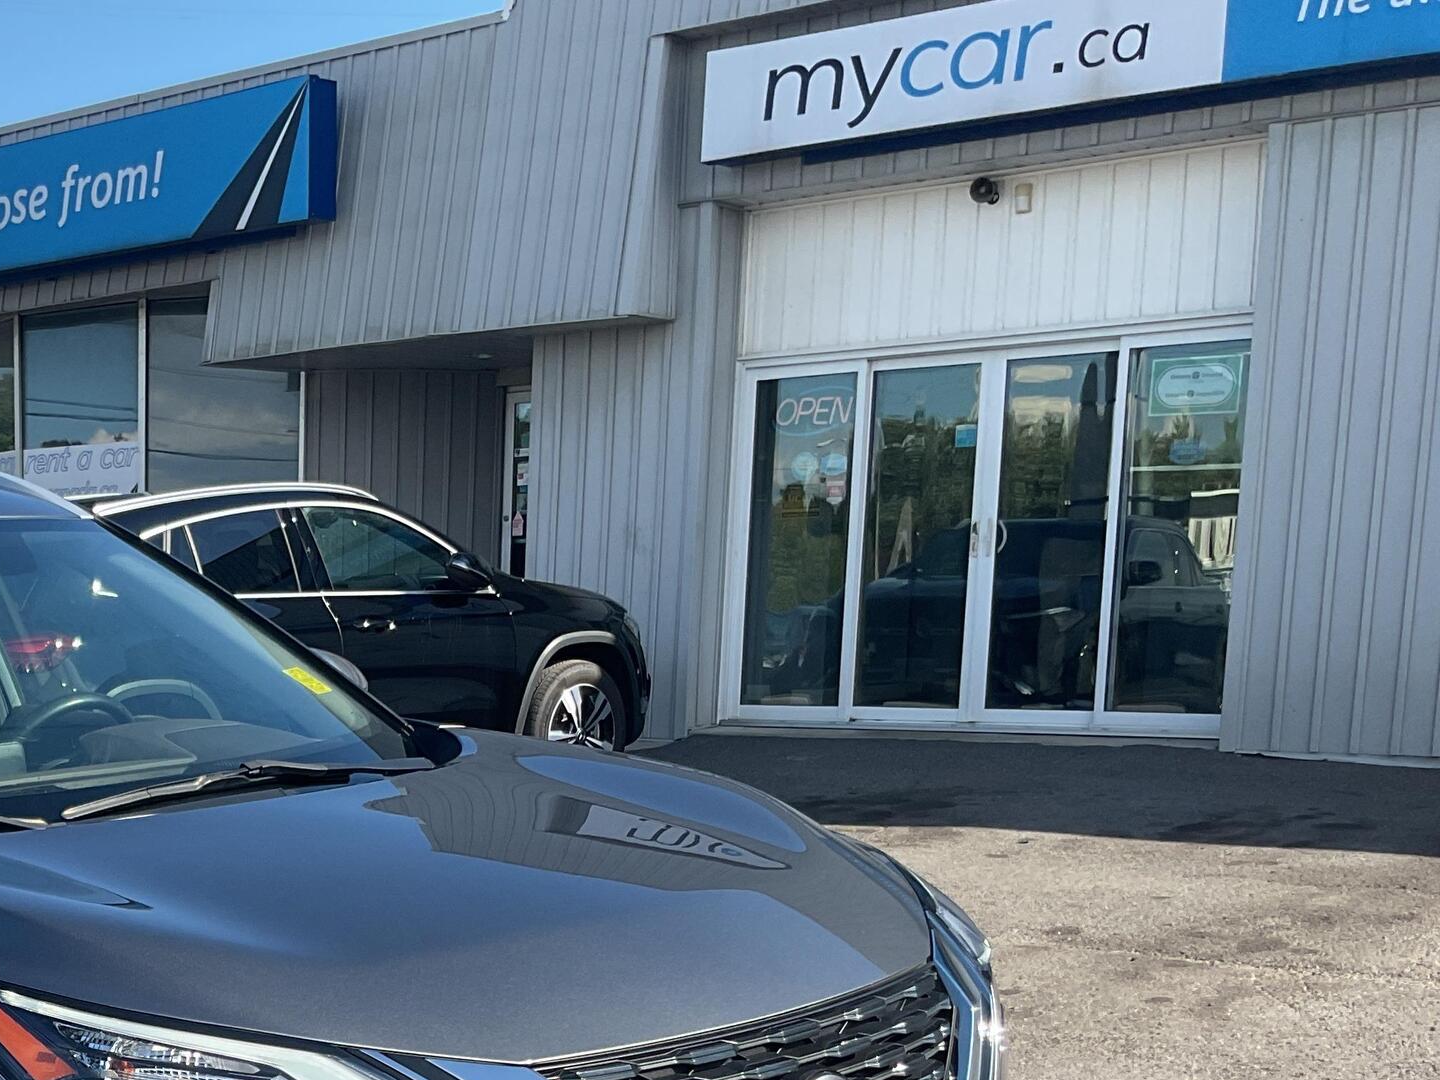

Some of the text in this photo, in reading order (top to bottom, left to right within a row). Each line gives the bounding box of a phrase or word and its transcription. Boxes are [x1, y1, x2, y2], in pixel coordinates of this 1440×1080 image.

[762, 19, 1151, 128] mycar.ca
[57, 150, 164, 228] from!
[775, 396, 854, 426] OPEN
[25, 447, 71, 475] rent
[76, 450, 92, 471] a
[100, 445, 139, 470] car
